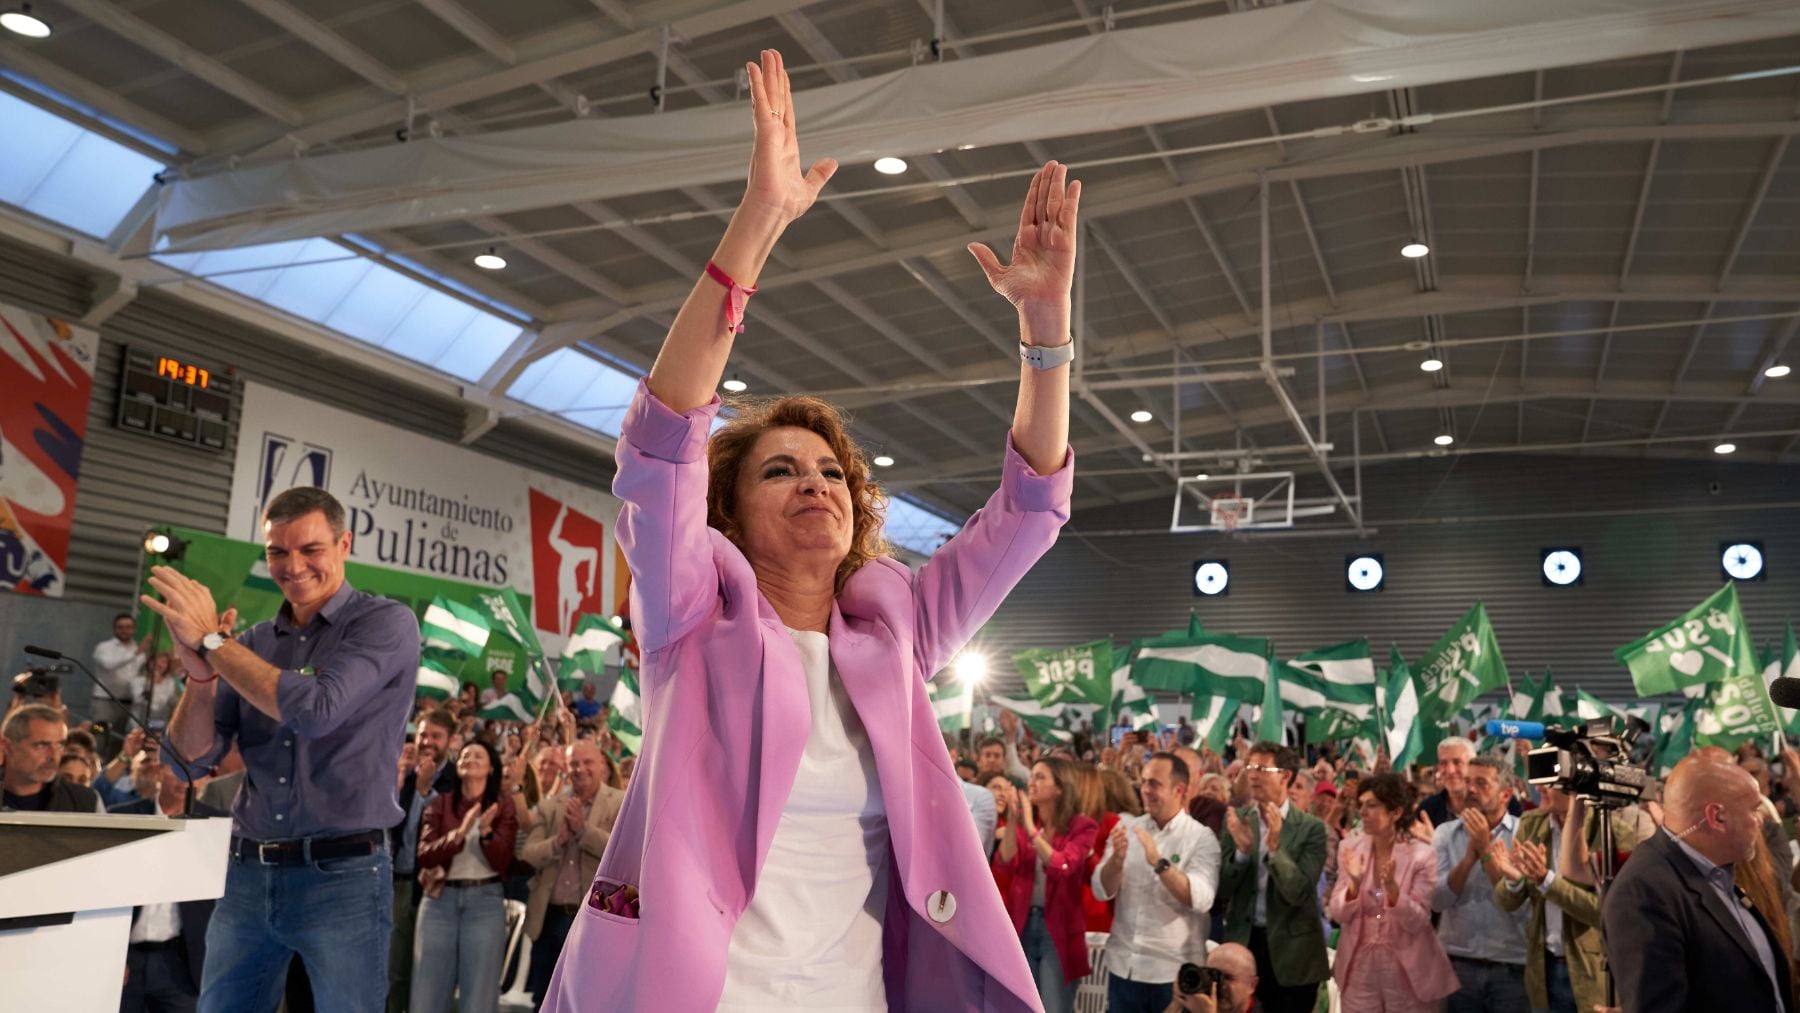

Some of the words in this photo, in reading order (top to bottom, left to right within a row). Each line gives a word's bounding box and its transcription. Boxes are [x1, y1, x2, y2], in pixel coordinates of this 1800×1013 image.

[158, 357, 209, 389] 19:37
[349, 468, 514, 534] Ayuntamiento
[348, 505, 509, 585] Pulianas
[441, 520, 459, 542] de
